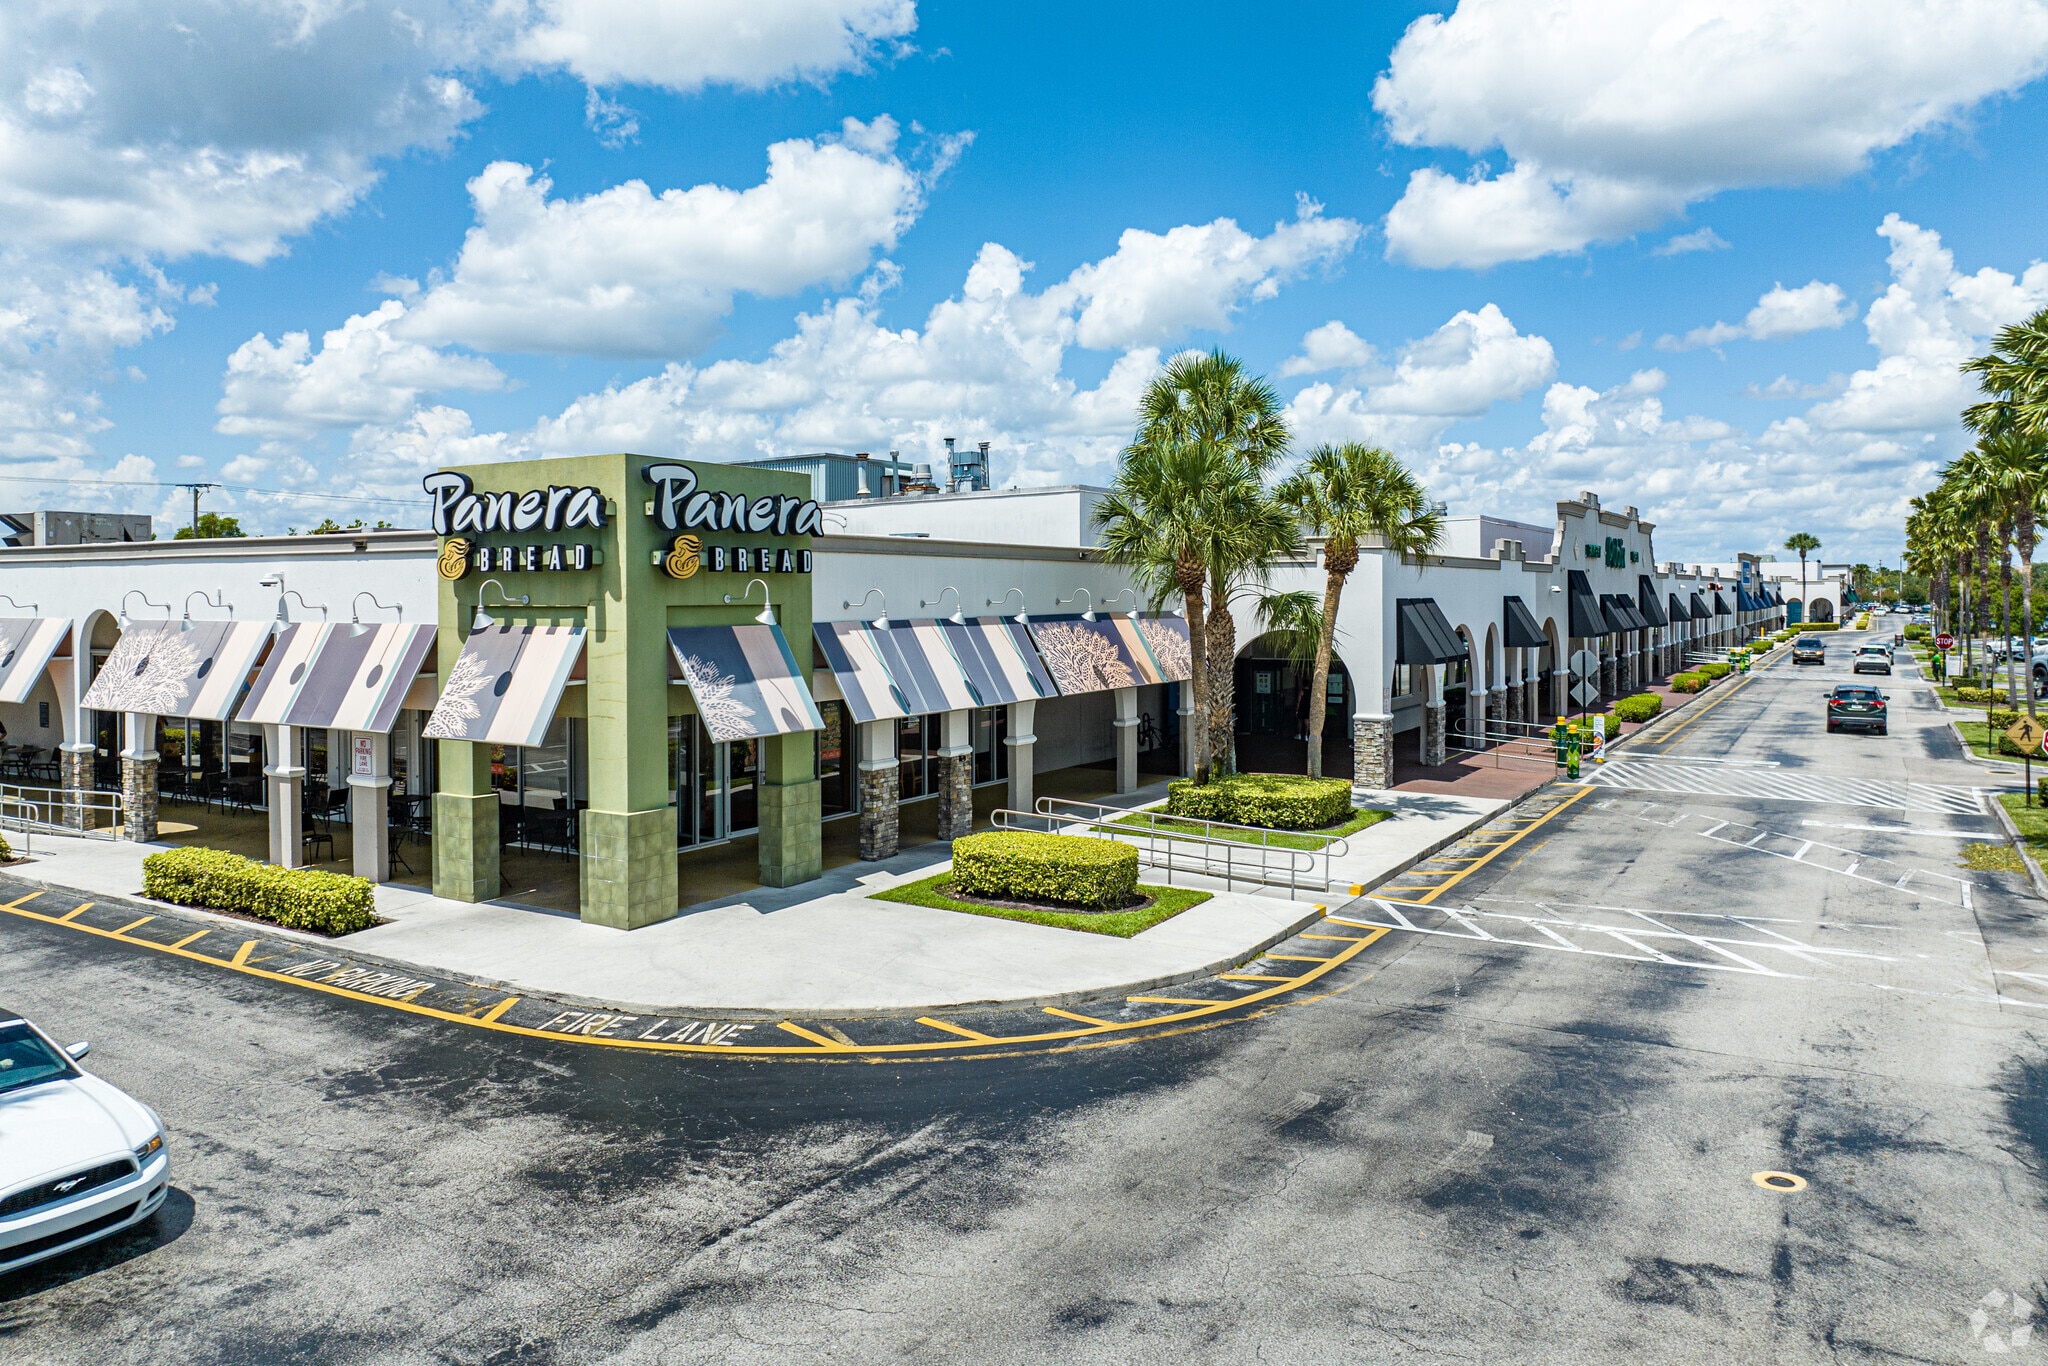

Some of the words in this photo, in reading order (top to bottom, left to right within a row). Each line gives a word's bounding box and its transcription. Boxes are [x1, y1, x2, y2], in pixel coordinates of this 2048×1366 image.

[423, 471, 607, 536] Panera
[641, 463, 824, 537] Panera
[480, 544, 592, 572] BREAD
[708, 546, 812, 573] BREAD
[1936, 637, 1953, 645] STOP
[355, 747, 372, 756] PARKING
[276, 959, 341, 977] NO
[314, 967, 436, 998] PARKING
[536, 1011, 639, 1036] FIRE
[637, 1018, 756, 1046] LANE
